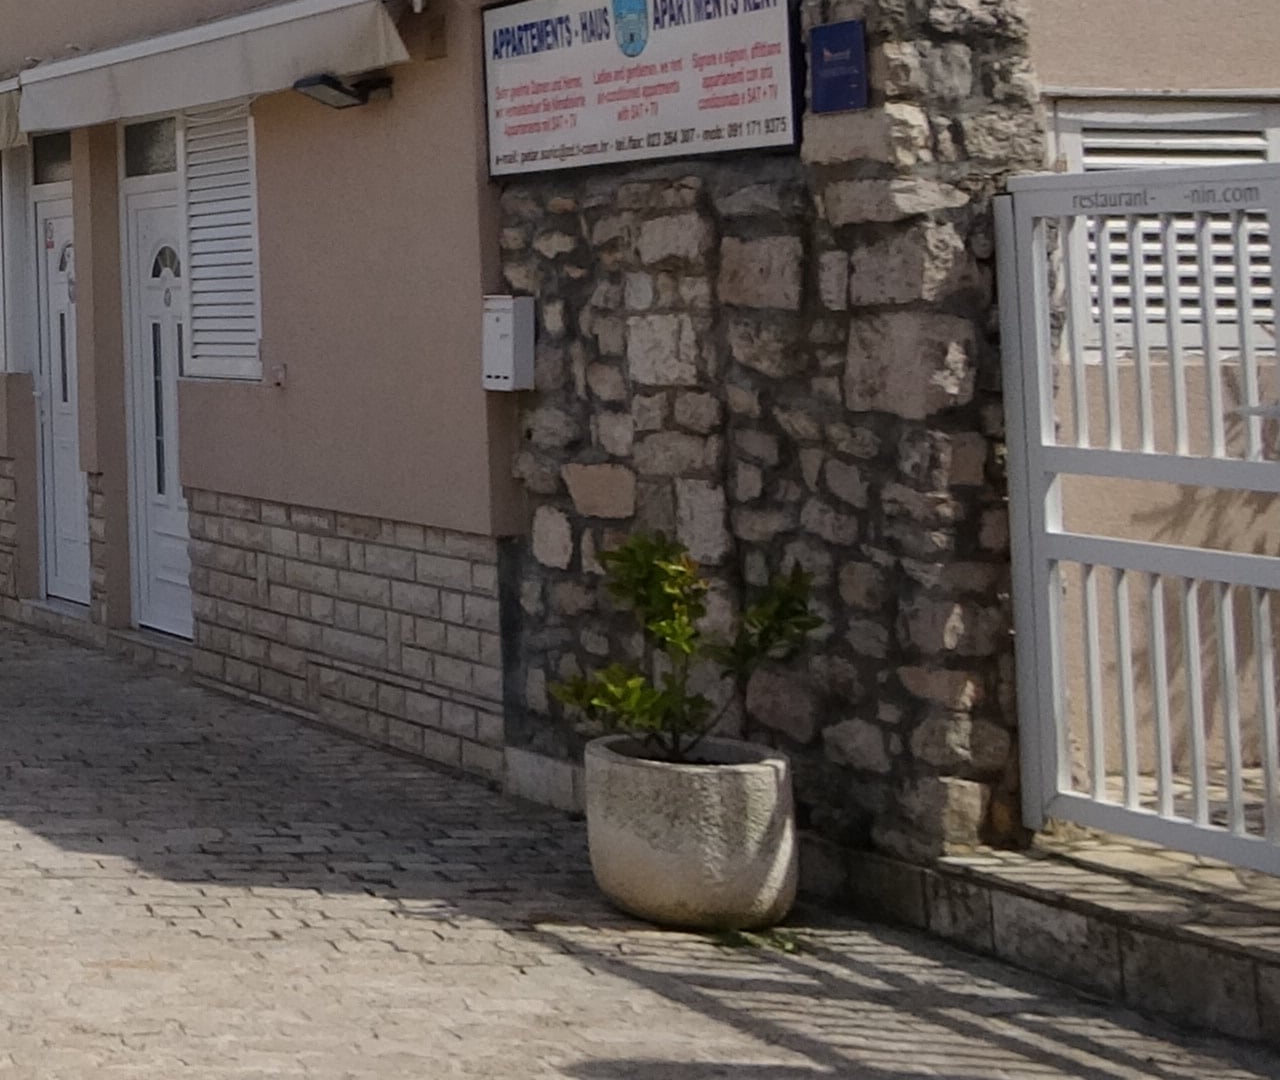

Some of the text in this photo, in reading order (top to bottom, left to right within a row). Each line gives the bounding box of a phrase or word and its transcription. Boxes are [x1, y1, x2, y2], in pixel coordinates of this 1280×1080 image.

[492, 15, 572, 60] APPARTEMENTS
[580, 7, 611, 43] HAUS
[747, 120, 761, 135] 171
